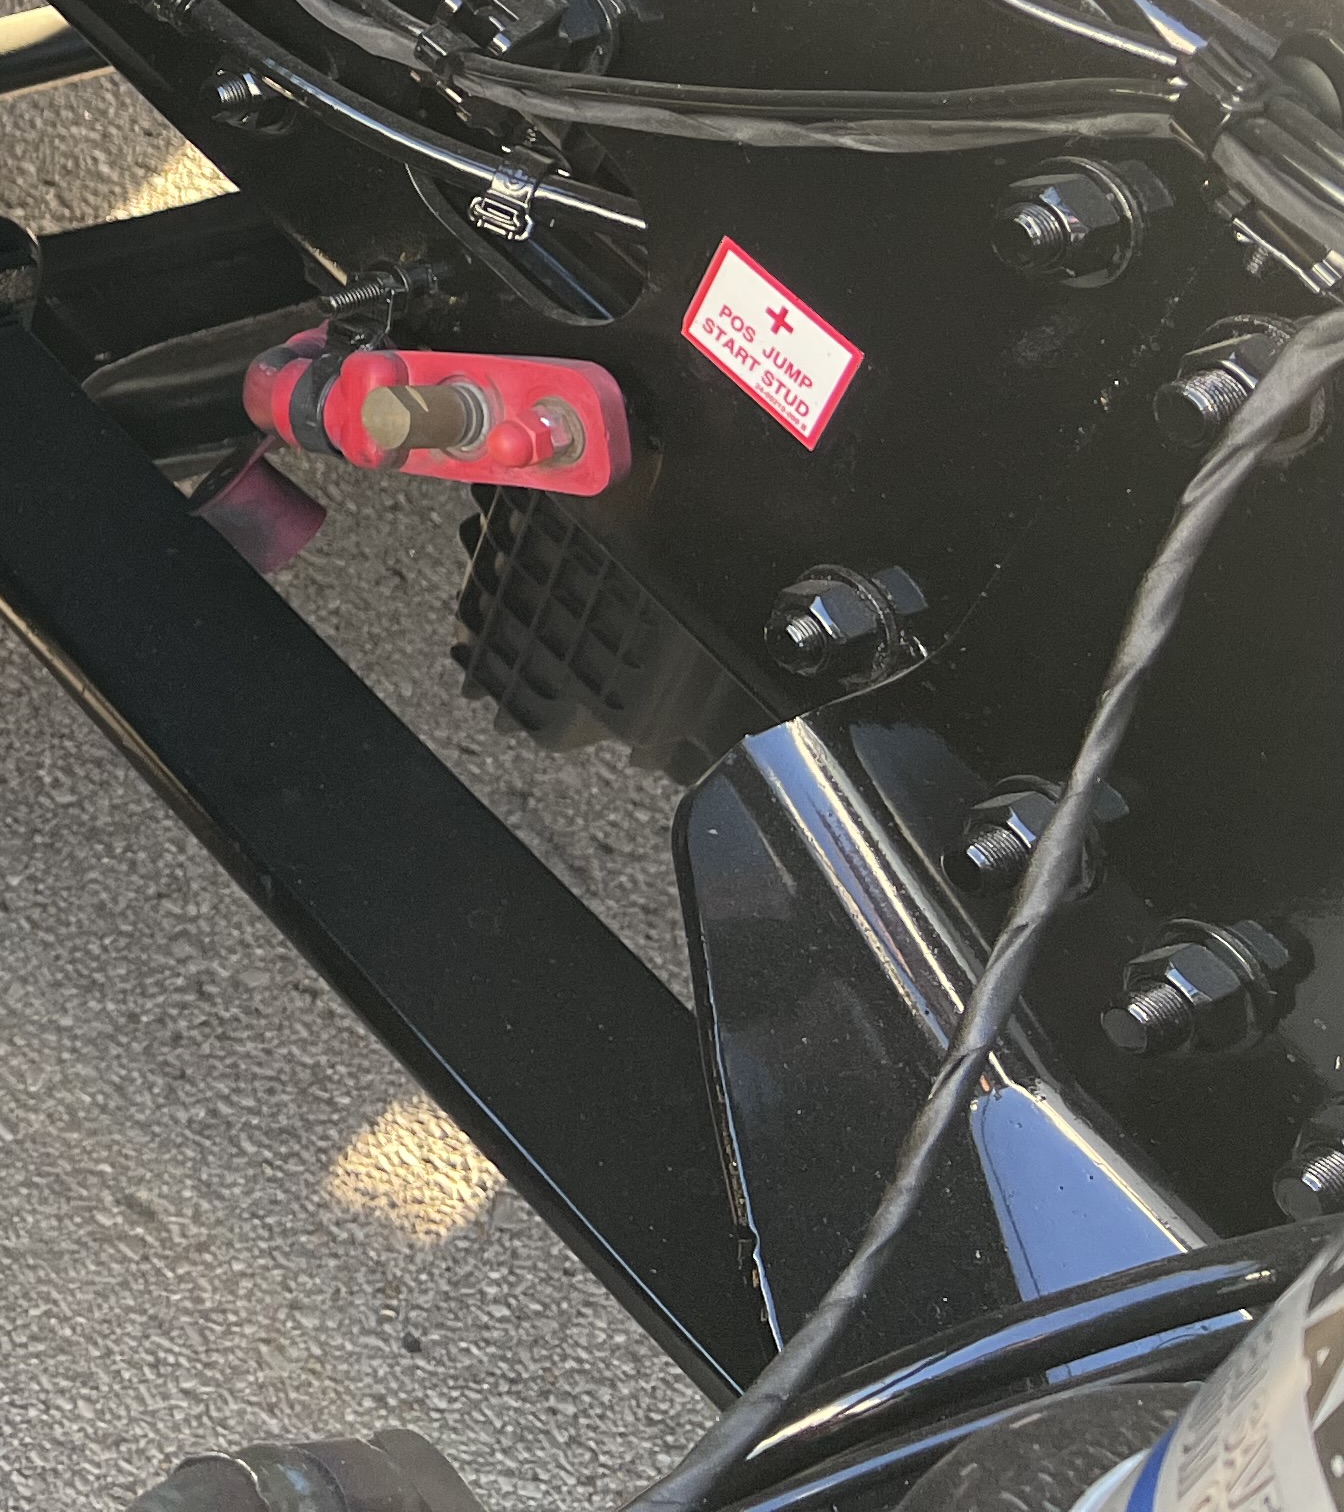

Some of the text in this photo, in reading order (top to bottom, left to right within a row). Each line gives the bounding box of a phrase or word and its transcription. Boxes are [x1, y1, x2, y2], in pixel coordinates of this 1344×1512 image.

[702, 317, 810, 418] START STUD
[718, 304, 813, 389] POS JUMP
